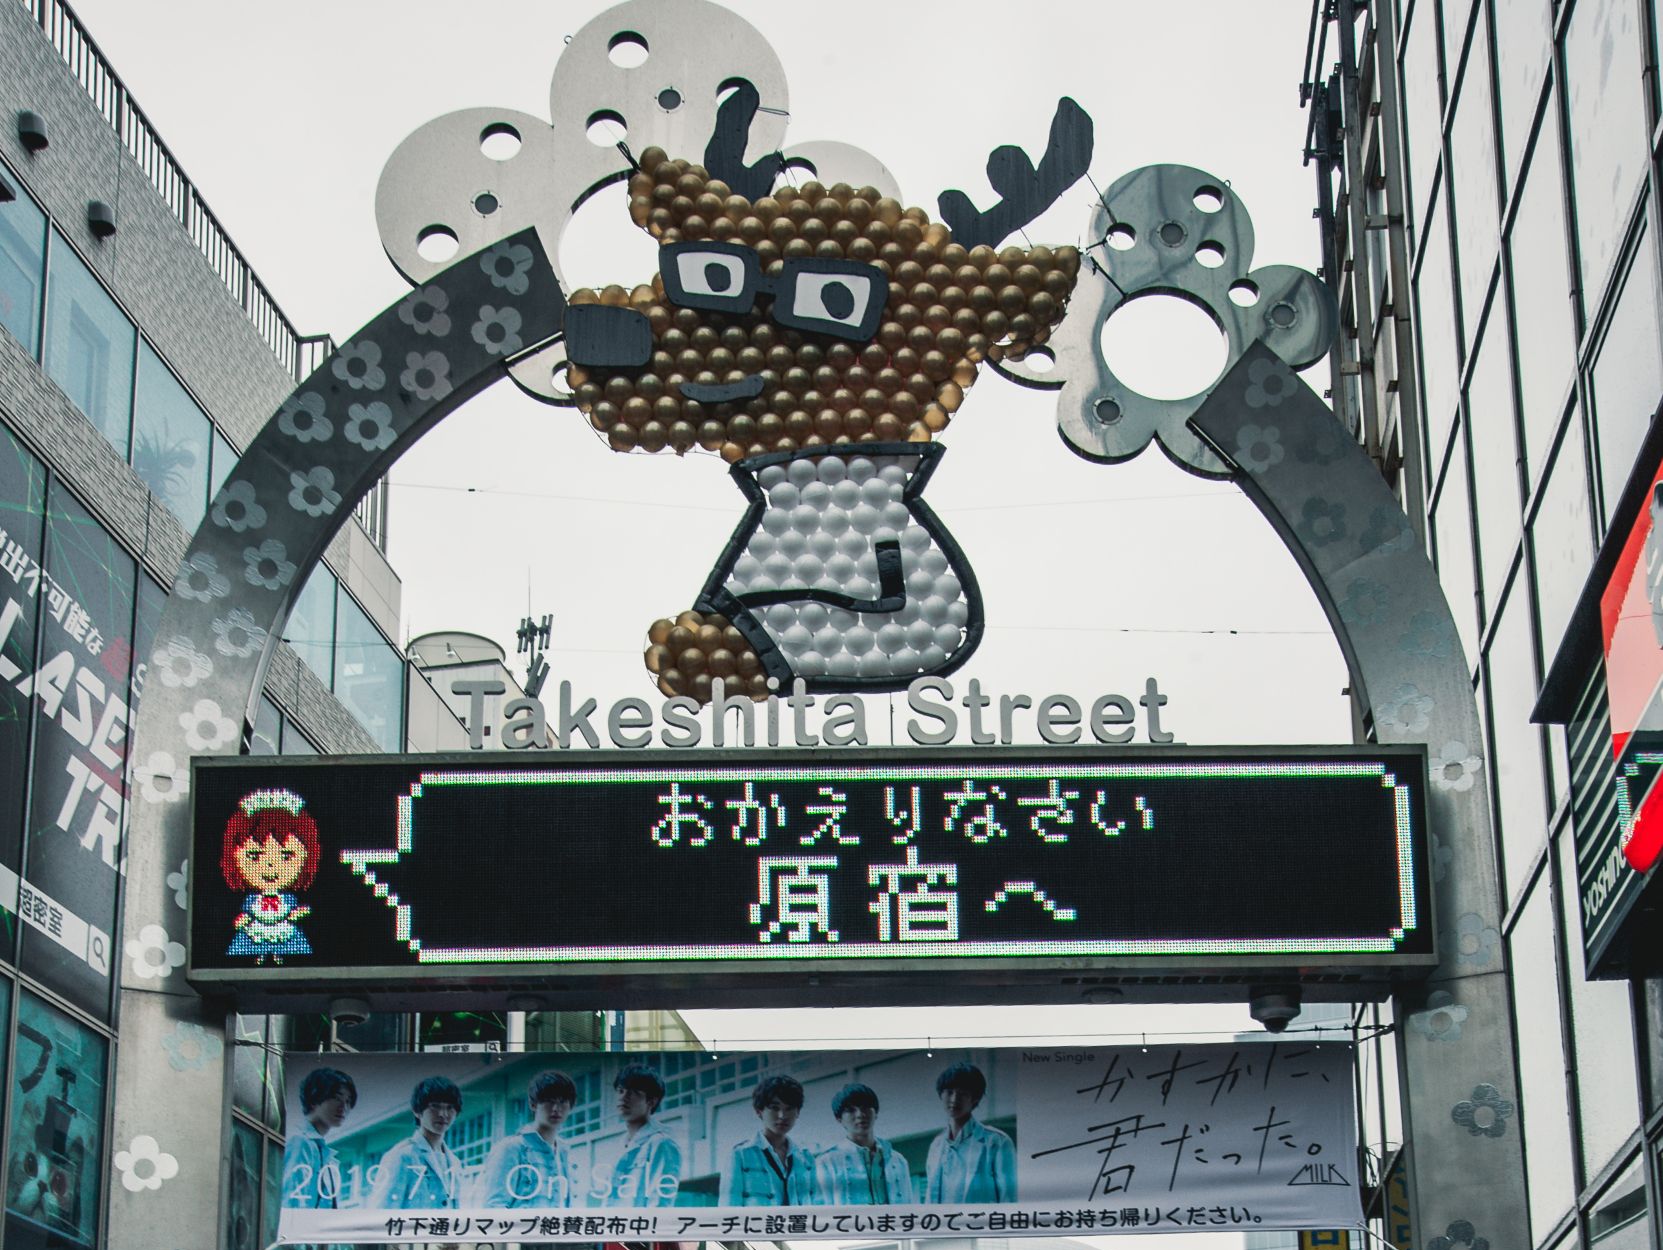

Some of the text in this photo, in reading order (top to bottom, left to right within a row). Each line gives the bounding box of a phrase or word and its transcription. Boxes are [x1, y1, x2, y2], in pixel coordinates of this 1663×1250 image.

[0, 597, 134, 784] LASE
[452, 677, 1175, 750] Takeshita Street
[651, 780, 1154, 847] おかえりなさい
[749, 847, 1077, 943] 原宿へ
[1022, 1051, 1095, 1065] New Single
[289, 1164, 679, 1200] 2019.7.1 On Sale
[1288, 1162, 1352, 1187] MILK
